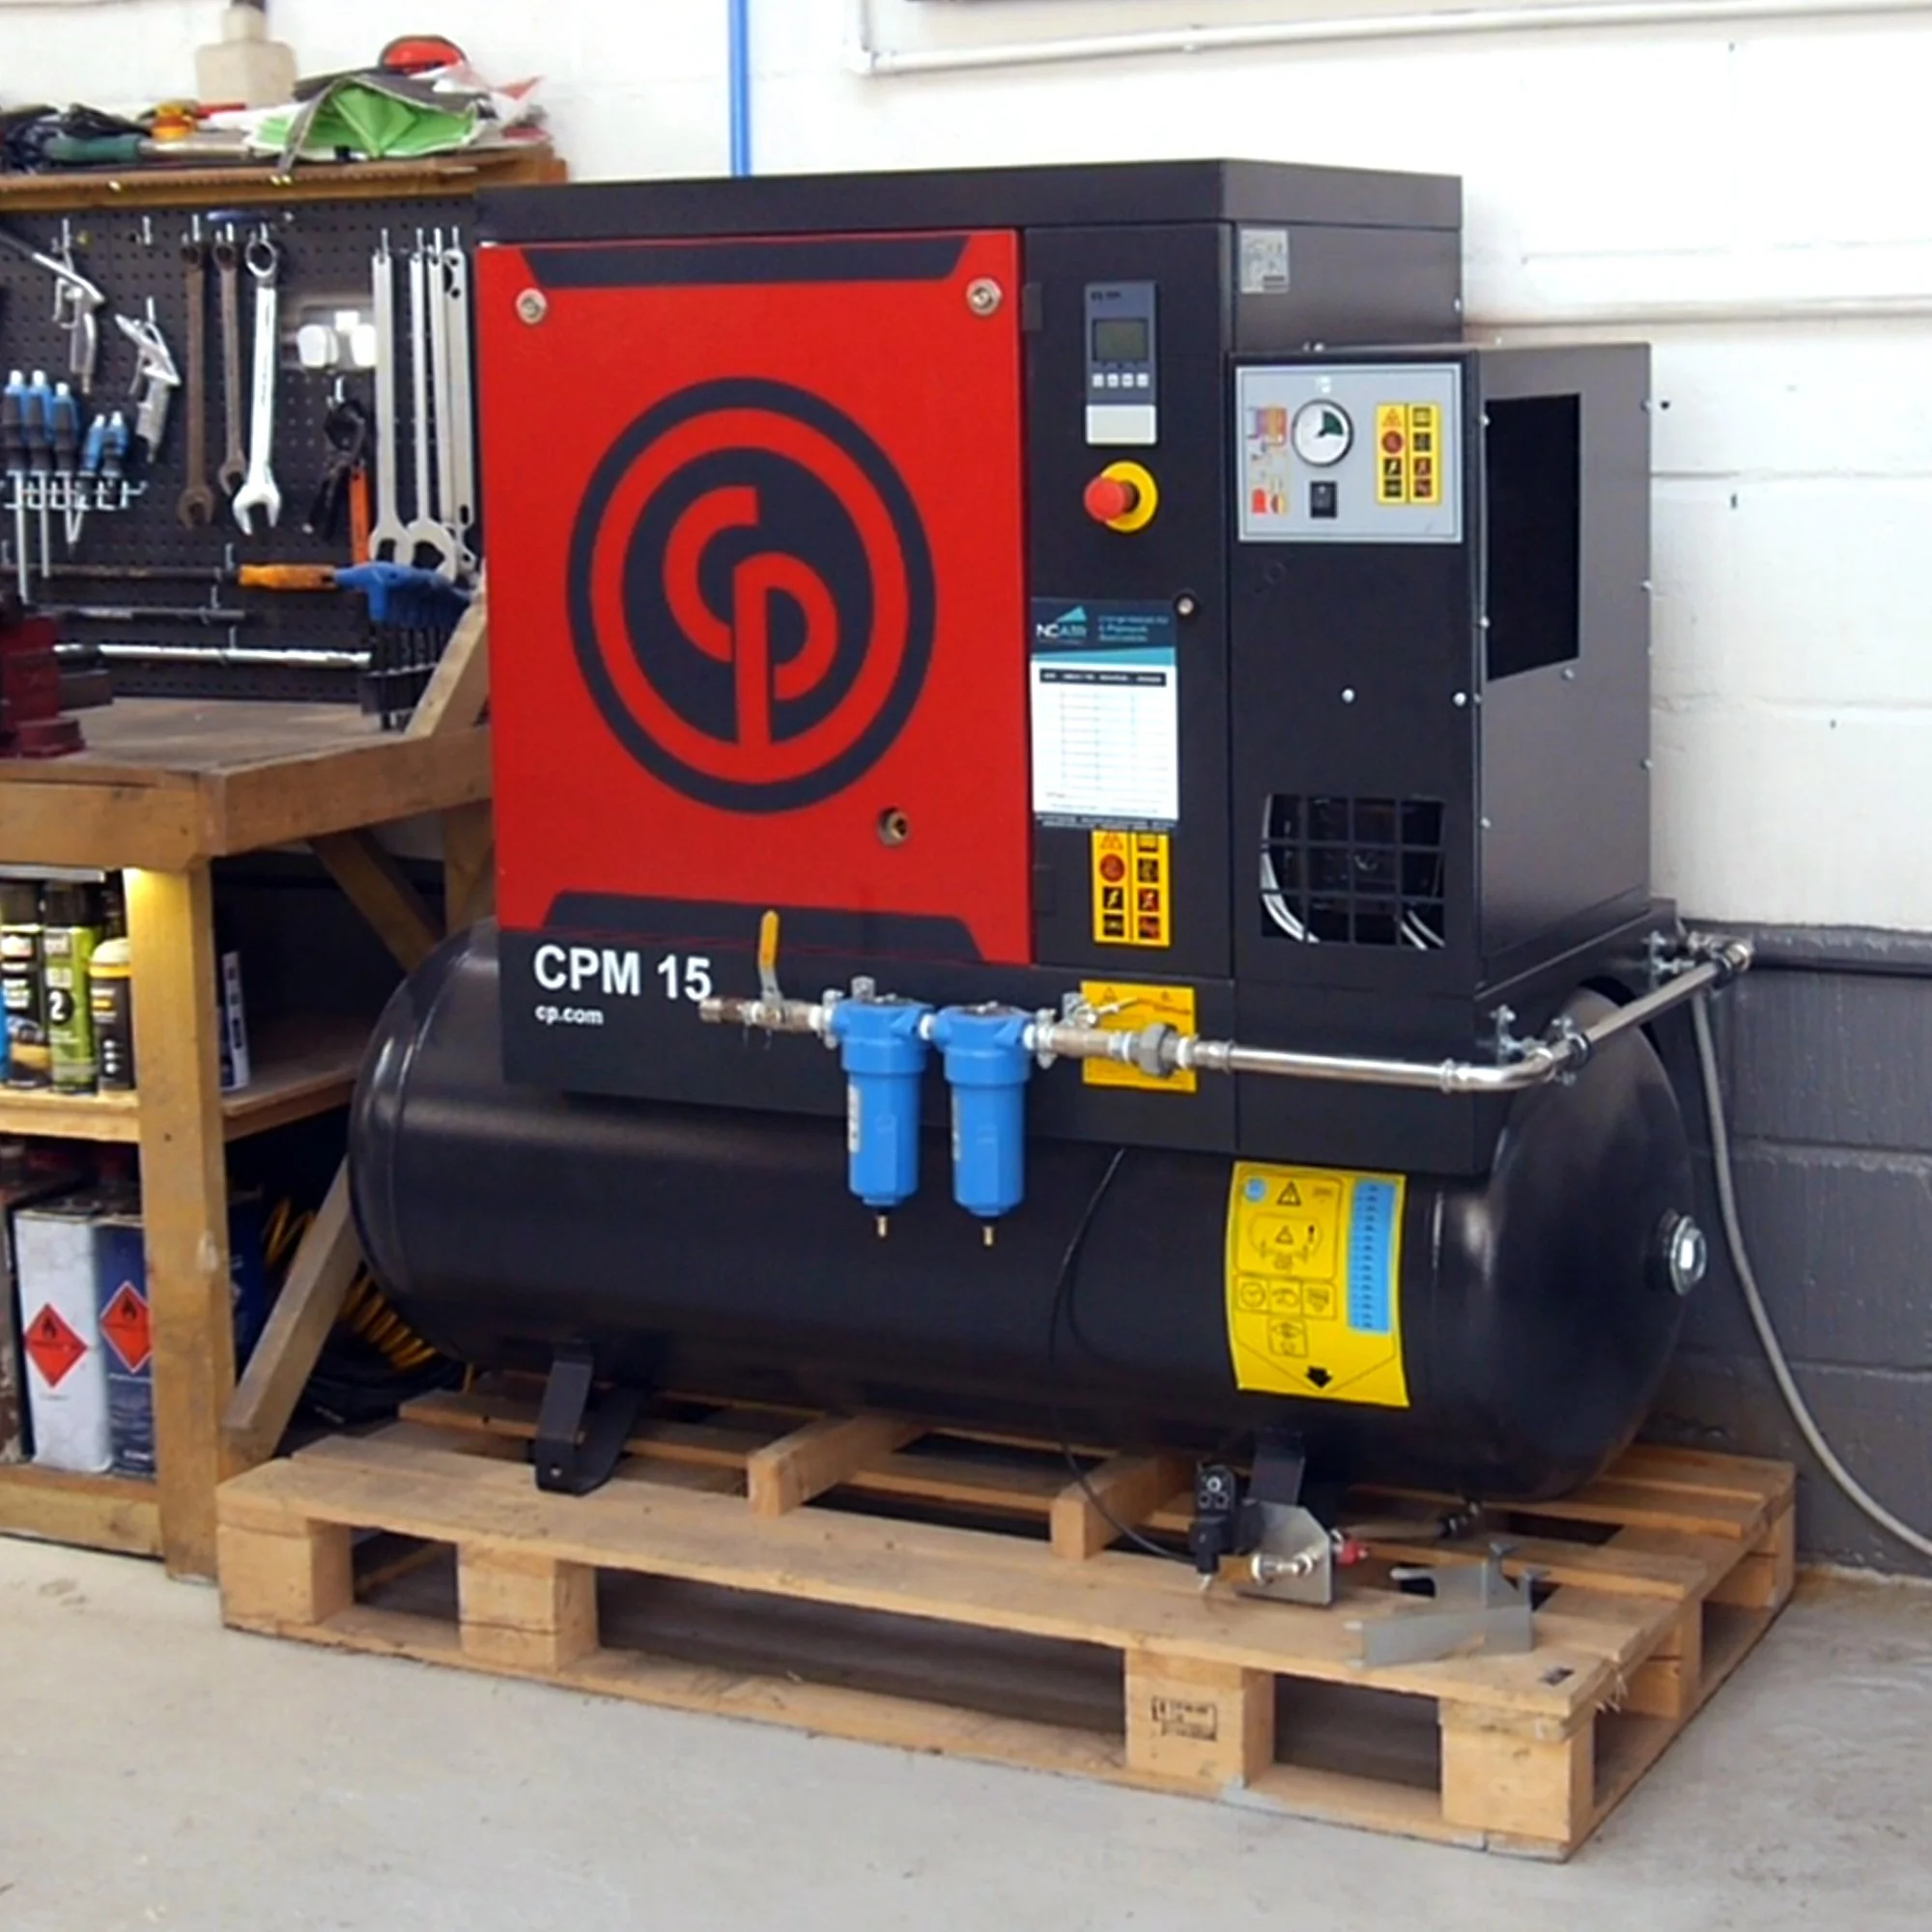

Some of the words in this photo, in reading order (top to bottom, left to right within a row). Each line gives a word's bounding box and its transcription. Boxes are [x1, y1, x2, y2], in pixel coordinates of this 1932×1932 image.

[533, 944, 641, 996] CPM
[657, 953, 713, 1002] 15
[48, 990, 67, 1021] 2
[534, 1005, 604, 1025] cp.com
